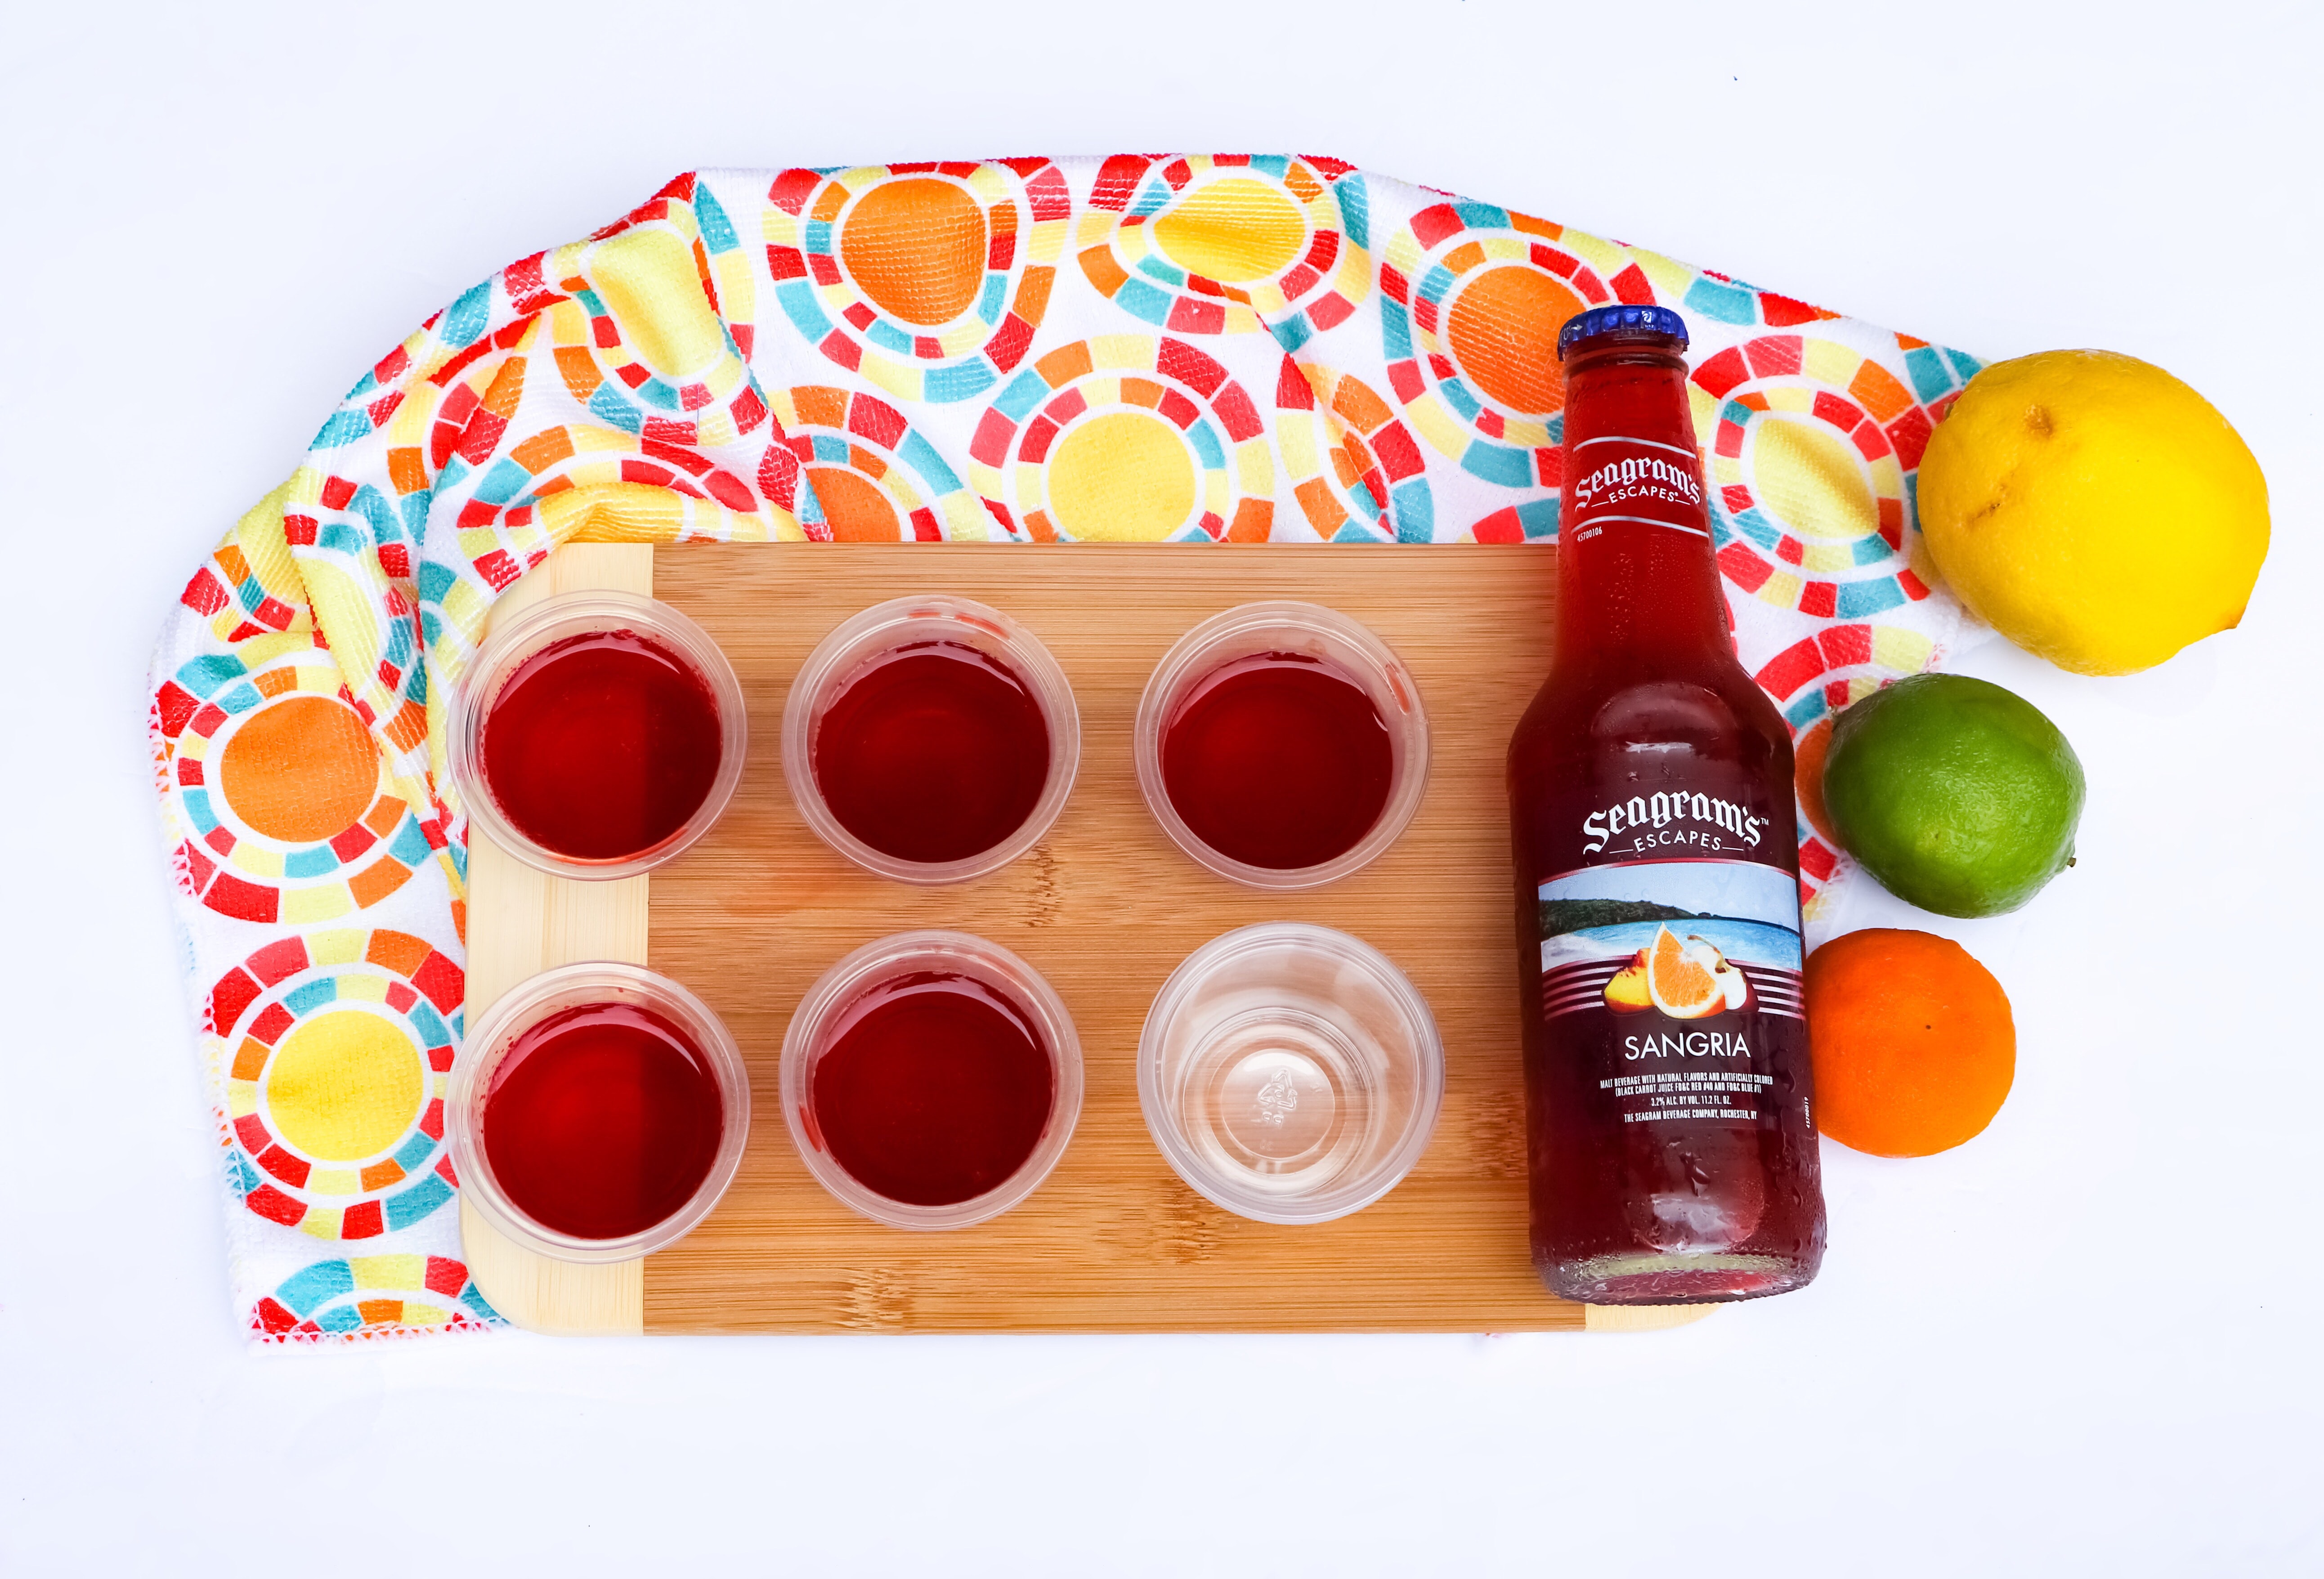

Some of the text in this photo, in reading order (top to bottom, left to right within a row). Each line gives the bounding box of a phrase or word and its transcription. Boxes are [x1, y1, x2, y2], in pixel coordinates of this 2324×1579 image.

[1575, 457, 1700, 512] Seagram's
[1609, 485, 1675, 503] ESCAPES
[1577, 526, 1602, 542] 45700106
[1583, 790, 1761, 854] Seagram's
[1633, 830, 1721, 853] ESCAPES
[1625, 1032, 1751, 1060] SANGRIA
[1600, 1072, 1773, 1088] MALT BEVERAGE WITH NATURAL FLAVORS AND ARTIFICIALLY COLORED
[1616, 1087, 1634, 1097] (BLACK
[1635, 1084, 1656, 1094] CARROT
[1658, 1083, 1674, 1092] JUICE
[1675, 1082, 1690, 1091] FD&C
[1691, 1082, 1702, 1091] RED
[1703, 1082, 1713, 1091] #40
[1715, 1082, 1725, 1091] AND
[1727, 1082, 1740, 1091] FD&C
[1742, 1083, 1753, 1092] BLUE
[1651, 1097, 1665, 1106] 3.2%
[1666, 1096, 1678, 1105] ALC.
[1679, 1096, 1686, 1105] BY
[1688, 1096, 1700, 1104] VOL.
[1702, 1096, 1712, 1104] 11.2
[1723, 1096, 1731, 1105] OZ.
[1624, 1109, 1756, 1123] THE SEAGRAM BEVERAGE COMPANY, ROCHESTER, NY
